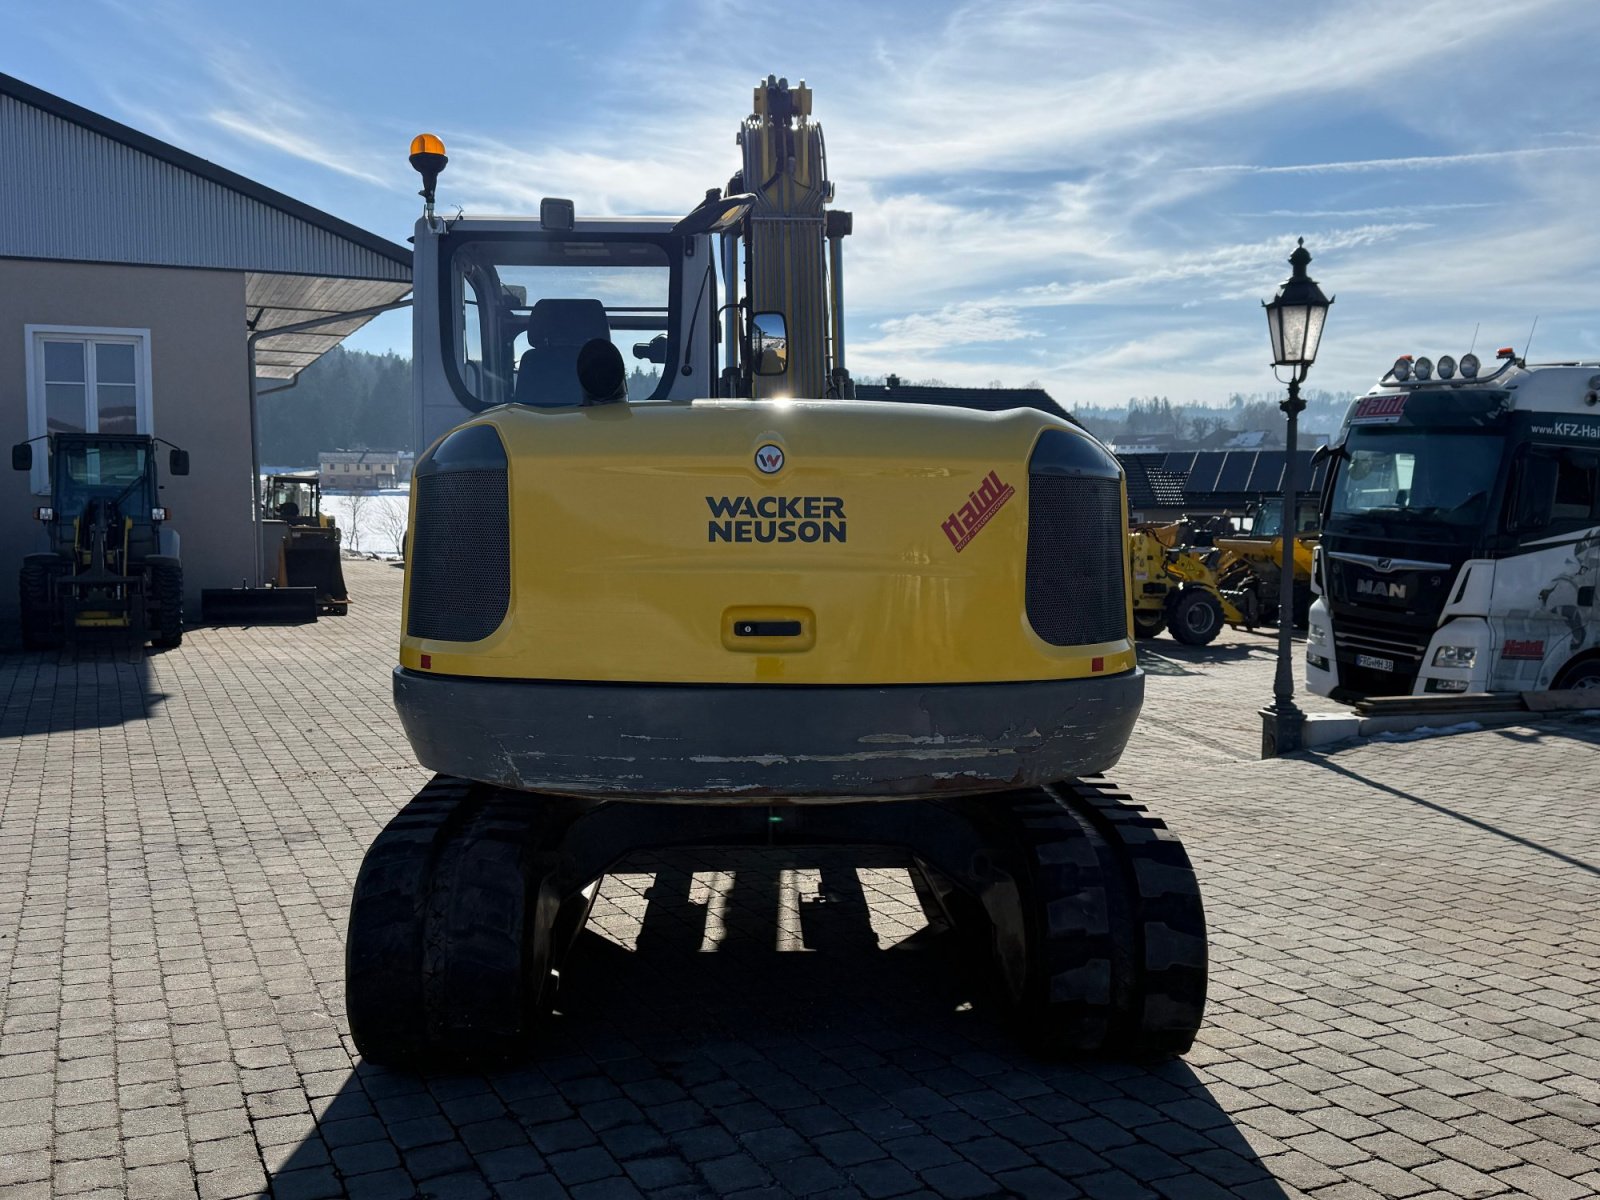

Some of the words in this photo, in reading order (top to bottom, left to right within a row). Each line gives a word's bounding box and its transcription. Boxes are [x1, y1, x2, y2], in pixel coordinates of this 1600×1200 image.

[705, 496, 847, 518] WACKER
[941, 470, 1009, 547] Haidl
[708, 521, 847, 543] NEUSON
[1357, 579, 1407, 598] MAN
